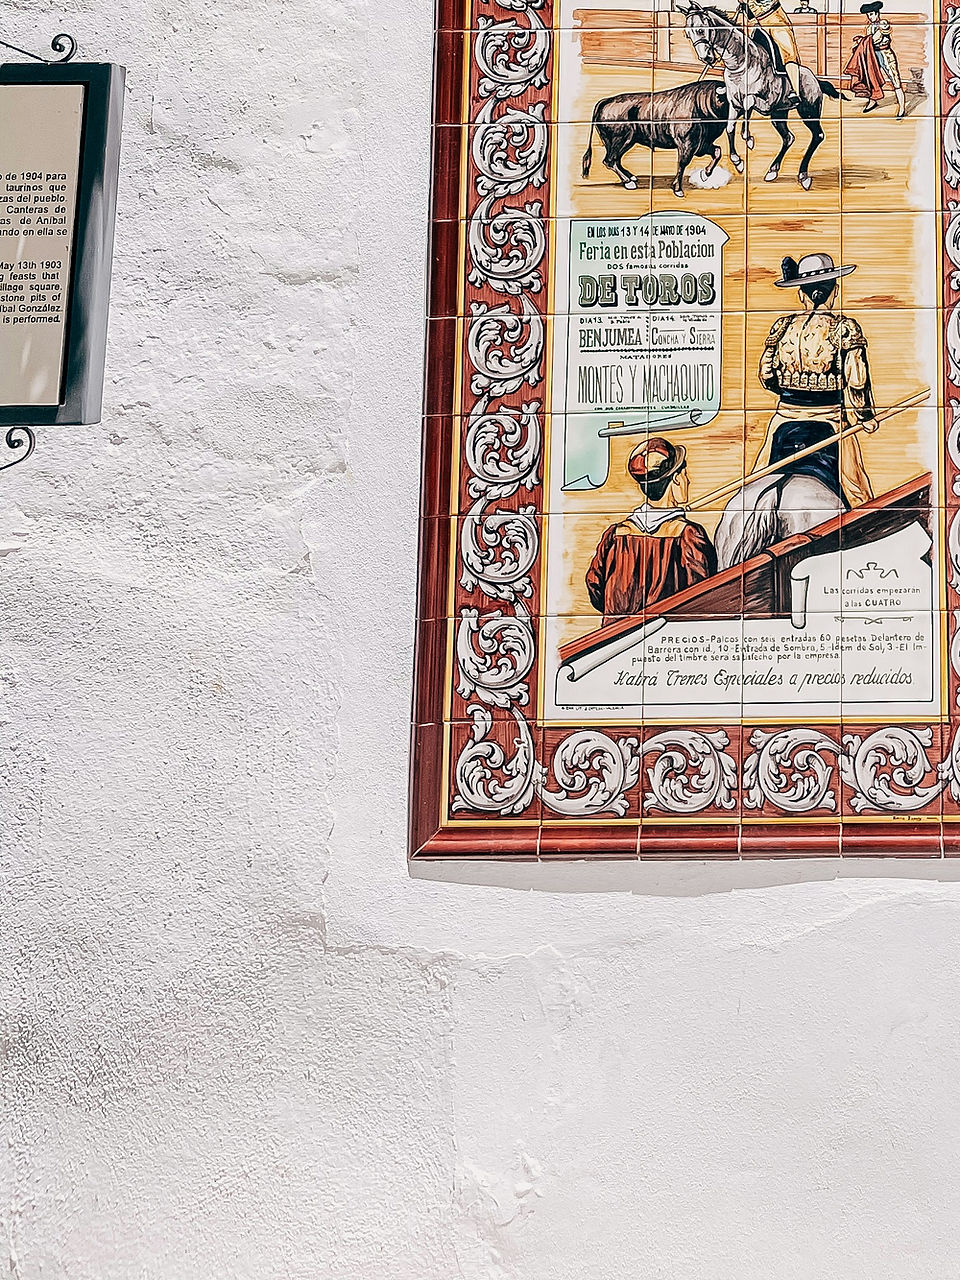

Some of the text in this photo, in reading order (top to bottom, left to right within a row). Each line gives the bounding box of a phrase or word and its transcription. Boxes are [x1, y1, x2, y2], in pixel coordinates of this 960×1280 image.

[5, 172, 17, 181] de
[20, 171, 43, 181] 1904
[45, 173, 67, 183] para
[6, 182, 67, 193] taurinos que
[17, 193, 31, 203] del
[6, 204, 67, 214] Canteras de
[19, 216, 32, 225] de
[0, 227, 20, 237] ndo
[36, 227, 54, 236] ella
[56, 228, 68, 236] se
[596, 226, 606, 238] LOS
[621, 226, 631, 237] 13
[633, 226, 638, 236] Y
[640, 225, 650, 237] 14
[676, 224, 683, 236] DE
[685, 224, 707, 237] 1904
[579, 238, 715, 261] Feria en esta Poblacion
[17, 260, 37, 270] 13th
[40, 260, 62, 270] 1903
[659, 261, 689, 269] corridas
[9, 271, 37, 281] feasts
[41, 271, 60, 280] that
[29, 283, 63, 293] square.
[578, 272, 716, 308] DE TOROS
[0, 292, 62, 304] stone pits of
[2, 315, 11, 324] is
[578, 327, 643, 348] BENJUMEA
[577, 363, 715, 404] MONTES Y MACHAQUITO
[823, 586, 839, 595] Las
[851, 600, 862, 608] las
[864, 598, 902, 608] CUATRO
[760, 635, 776, 643] seis
[780, 633, 817, 642] entradas
[871, 633, 912, 642] Delantero
[915, 632, 925, 641] de
[647, 645, 681, 654] Barrera
[770, 643, 781, 652] de
[856, 643, 866, 652] de
[664, 653, 677, 662] del
[777, 653, 791, 664] por
[793, 651, 801, 660] la
[666, 669, 709, 687] Trenes
[713, 666, 784, 692] Especiales
[789, 672, 798, 686] a
[798, 668, 846, 693] precios
